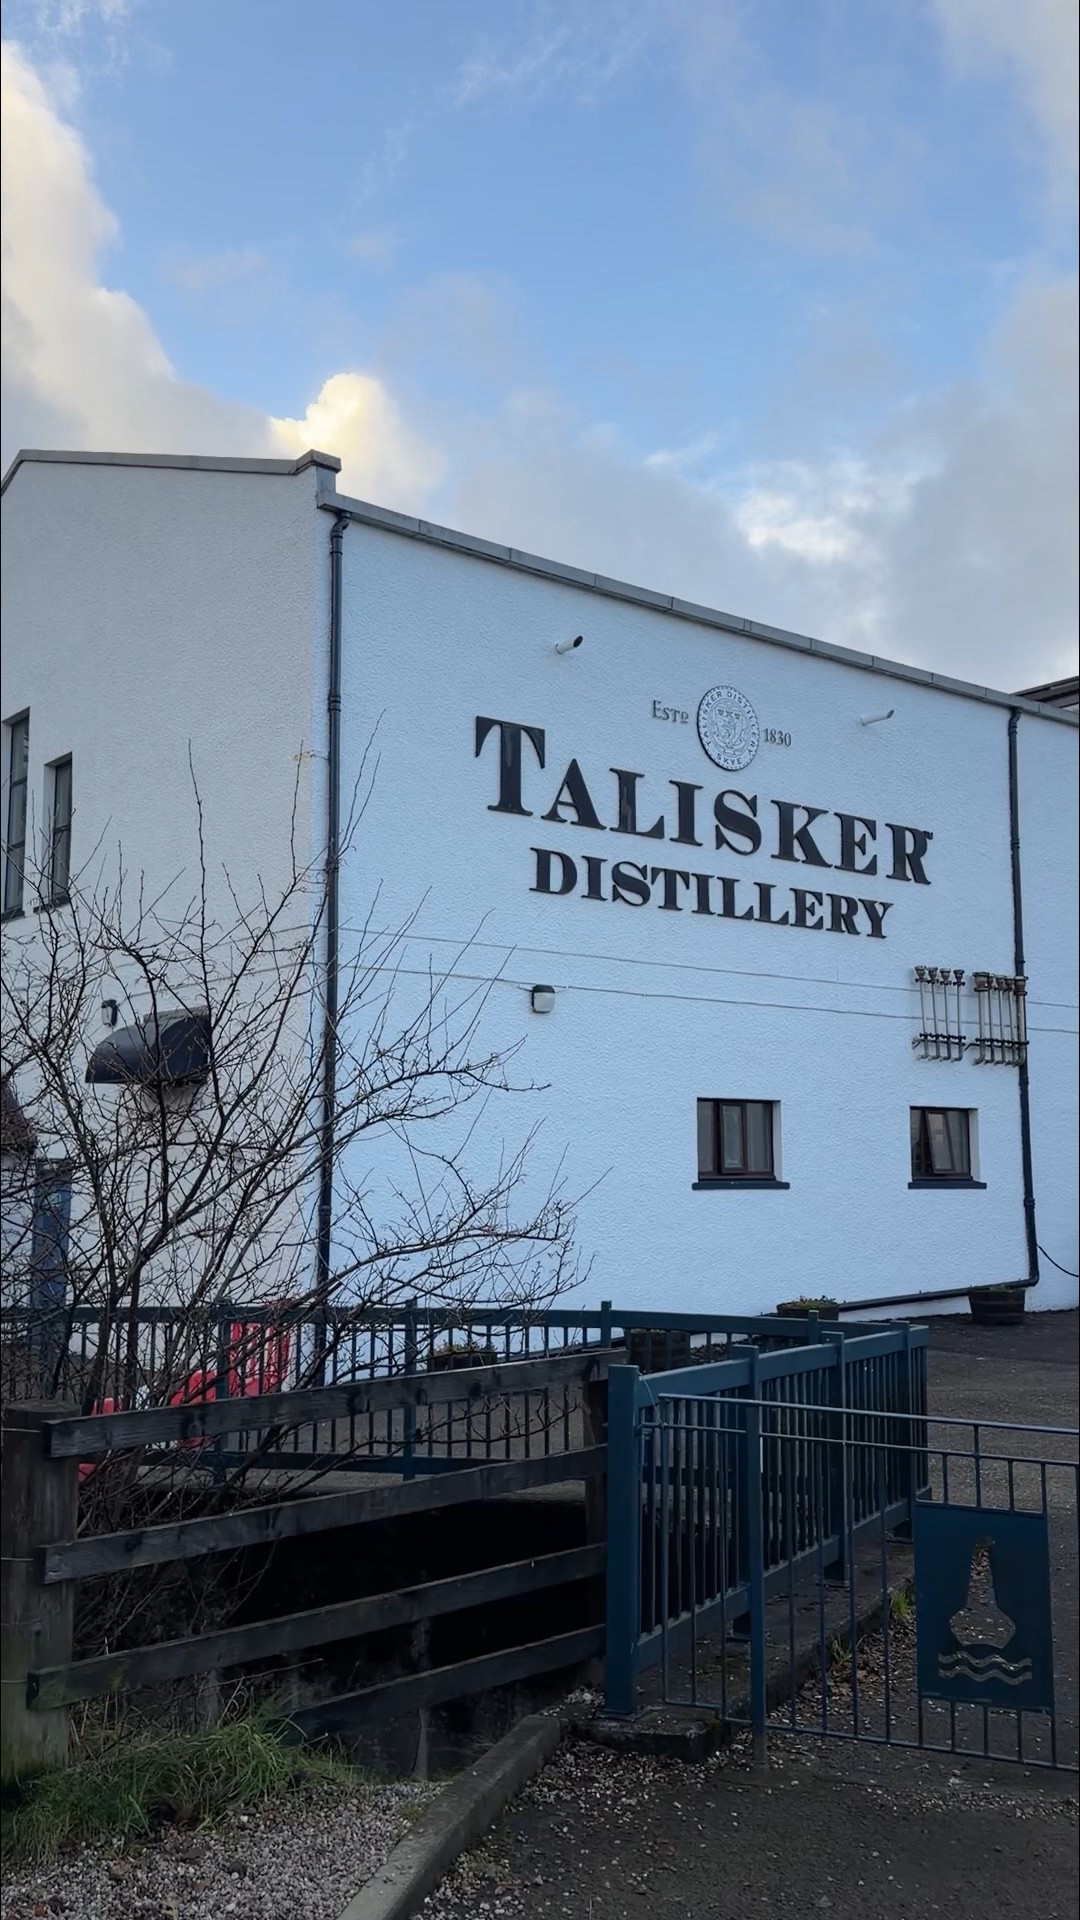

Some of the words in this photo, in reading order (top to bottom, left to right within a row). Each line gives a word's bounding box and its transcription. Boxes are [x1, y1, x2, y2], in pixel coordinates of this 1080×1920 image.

[716, 753, 743, 765] SKYE
[764, 728, 792, 747] 1830
[474, 715, 933, 885] TALISKER
[529, 847, 894, 939] DISTILLERY
